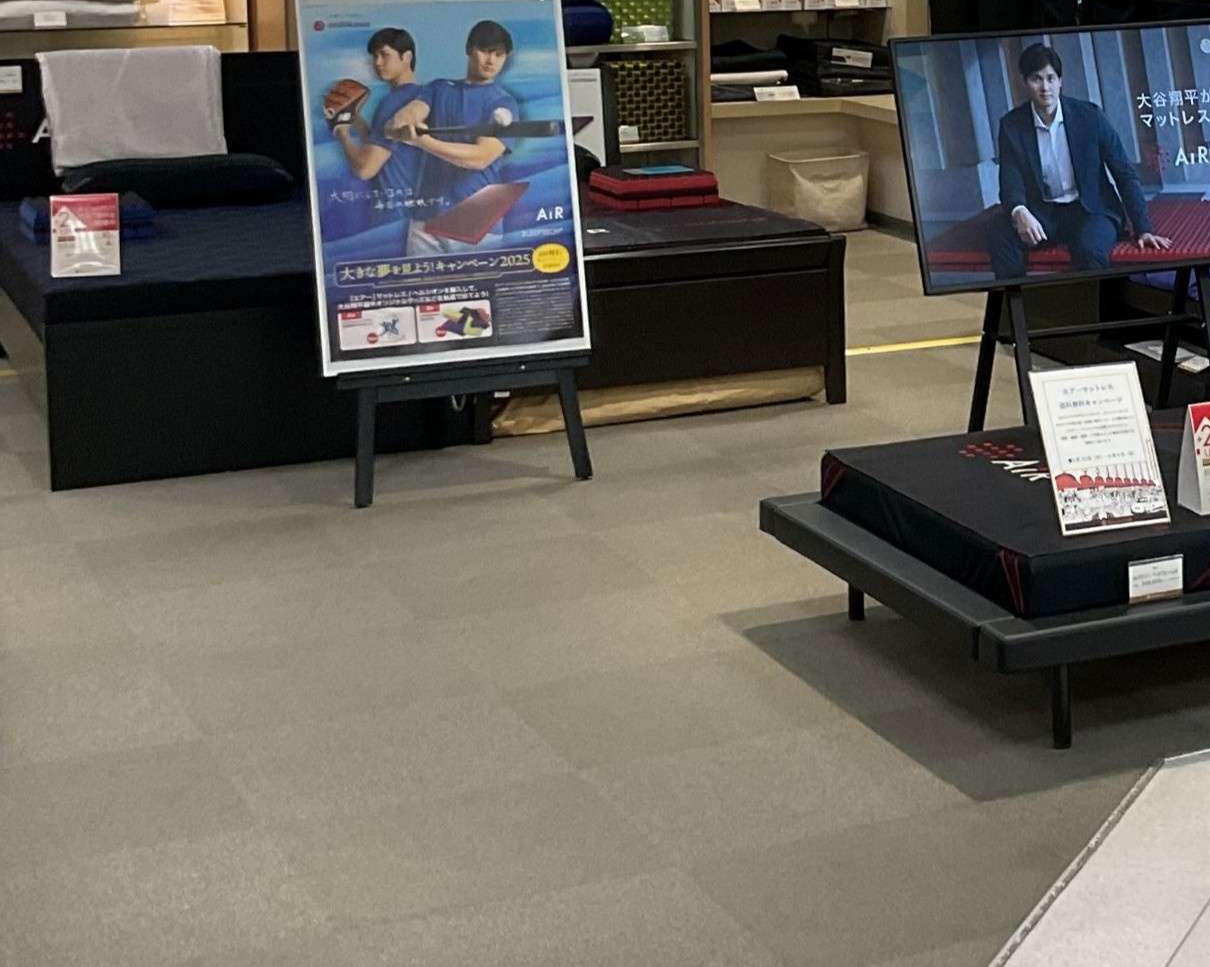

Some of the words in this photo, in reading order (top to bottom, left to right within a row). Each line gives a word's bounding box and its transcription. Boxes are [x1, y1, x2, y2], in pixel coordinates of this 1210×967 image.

[1139, 109, 1210, 128] マットレス
